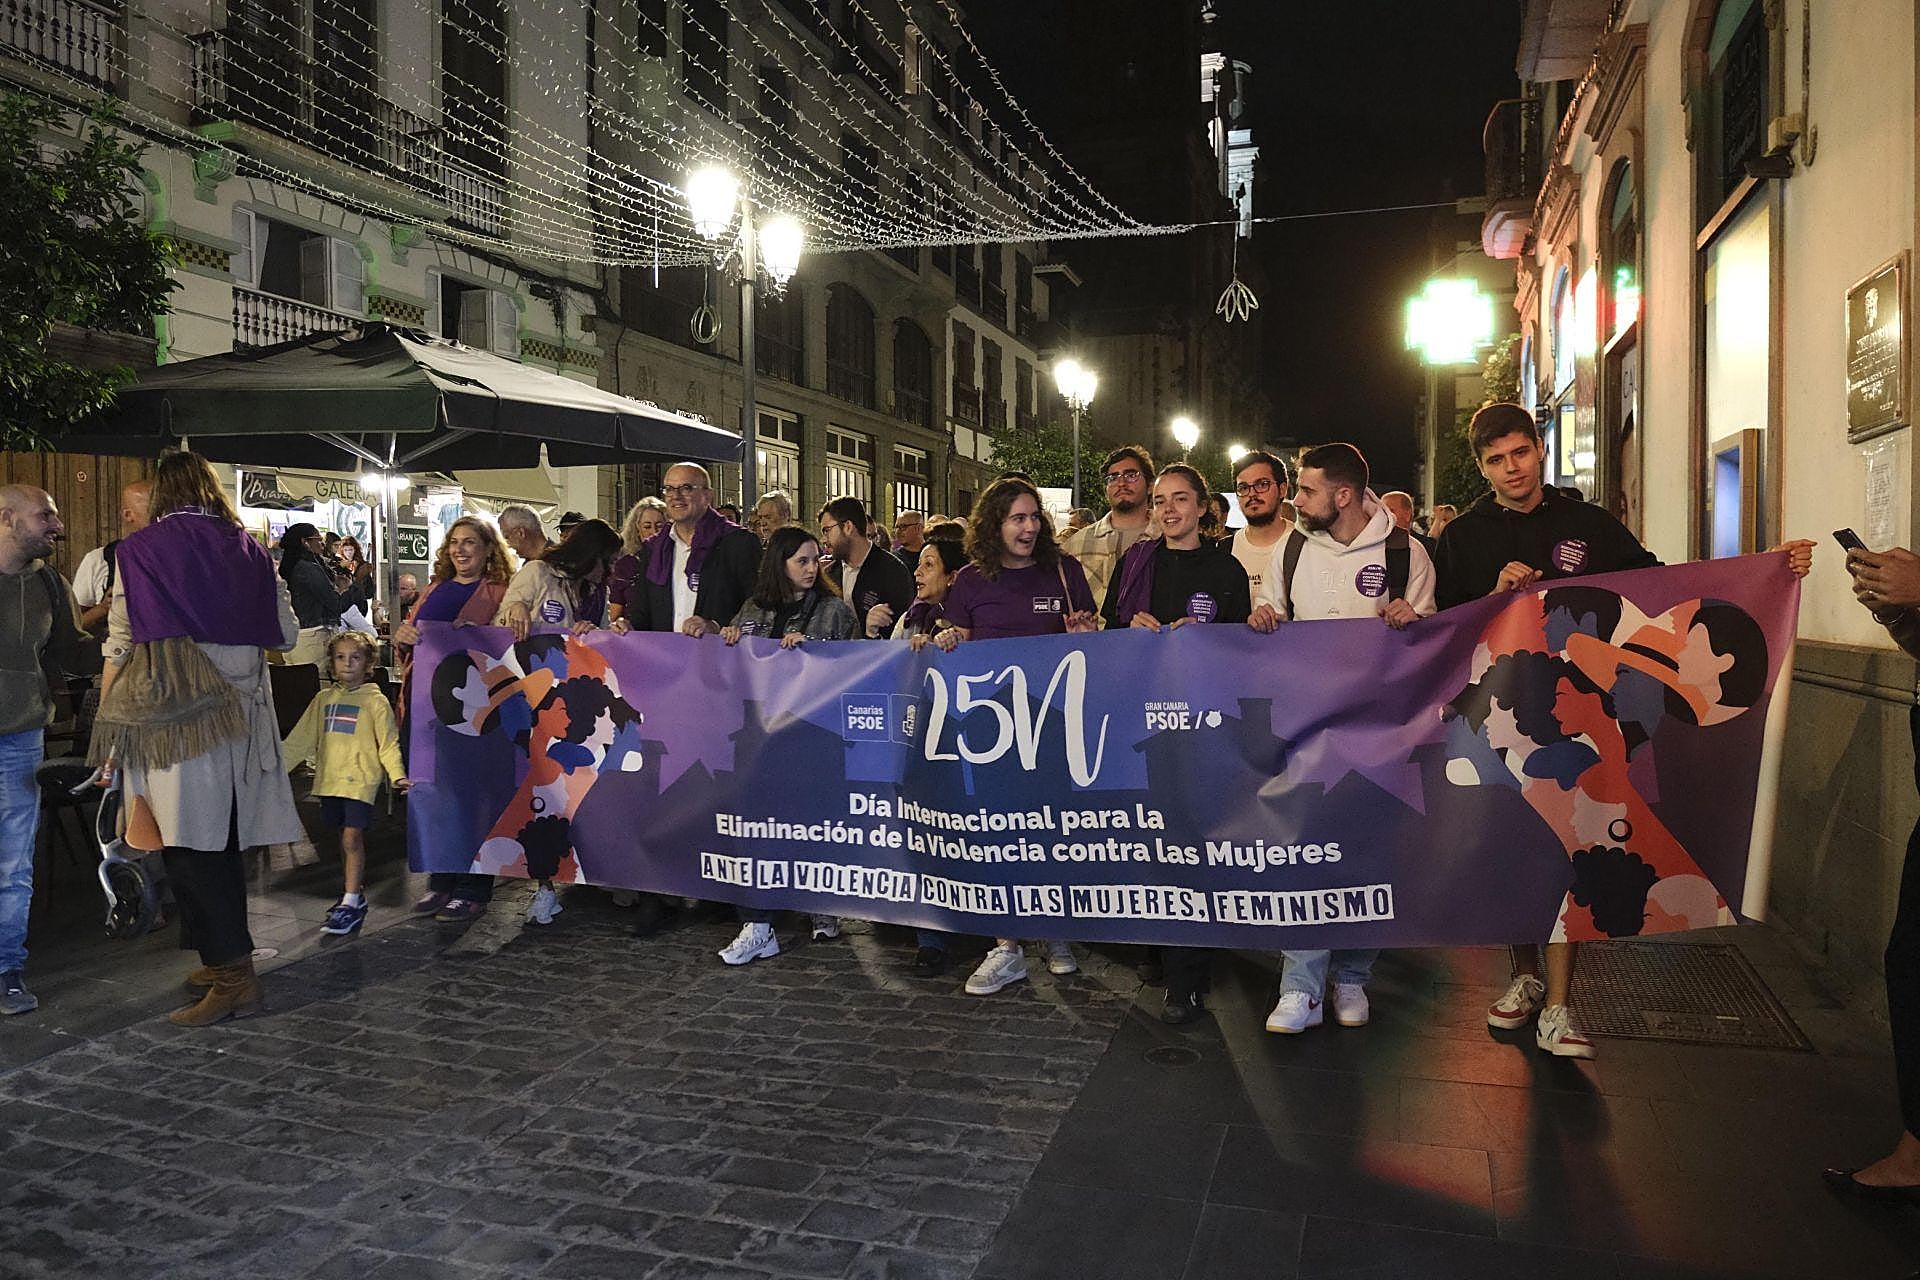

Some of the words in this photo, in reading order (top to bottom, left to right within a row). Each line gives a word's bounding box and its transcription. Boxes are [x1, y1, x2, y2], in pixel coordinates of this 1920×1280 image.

[848, 704, 884, 717] Canarias
[1144, 702, 1161, 711] GRAN
[1162, 701, 1190, 711] CANARIA
[848, 716, 885, 731] PSOE
[1145, 711, 1191, 730] PSOE
[850, 793, 892, 818] Día
[897, 796, 1056, 832] Internacional
[1060, 807, 1131, 836] para
[1135, 803, 1165, 831] la
[715, 813, 864, 845] Eliminación
[869, 825, 903, 850] de
[907, 827, 926, 853] la
[926, 832, 1046, 863] Violencia
[1051, 837, 1151, 863] contra
[1155, 838, 1200, 866] las
[1205, 839, 1342, 873] Mujeres
[702, 854, 750, 885] ANTE
[760, 861, 786, 887] LA
[796, 864, 913, 899] VIOLENCIA
[922, 876, 1006, 913] CONTRA
[1017, 886, 1062, 915] LAS
[1073, 887, 1207, 919] MUJERES,
[1219, 886, 1390, 923] FEMINISMO
